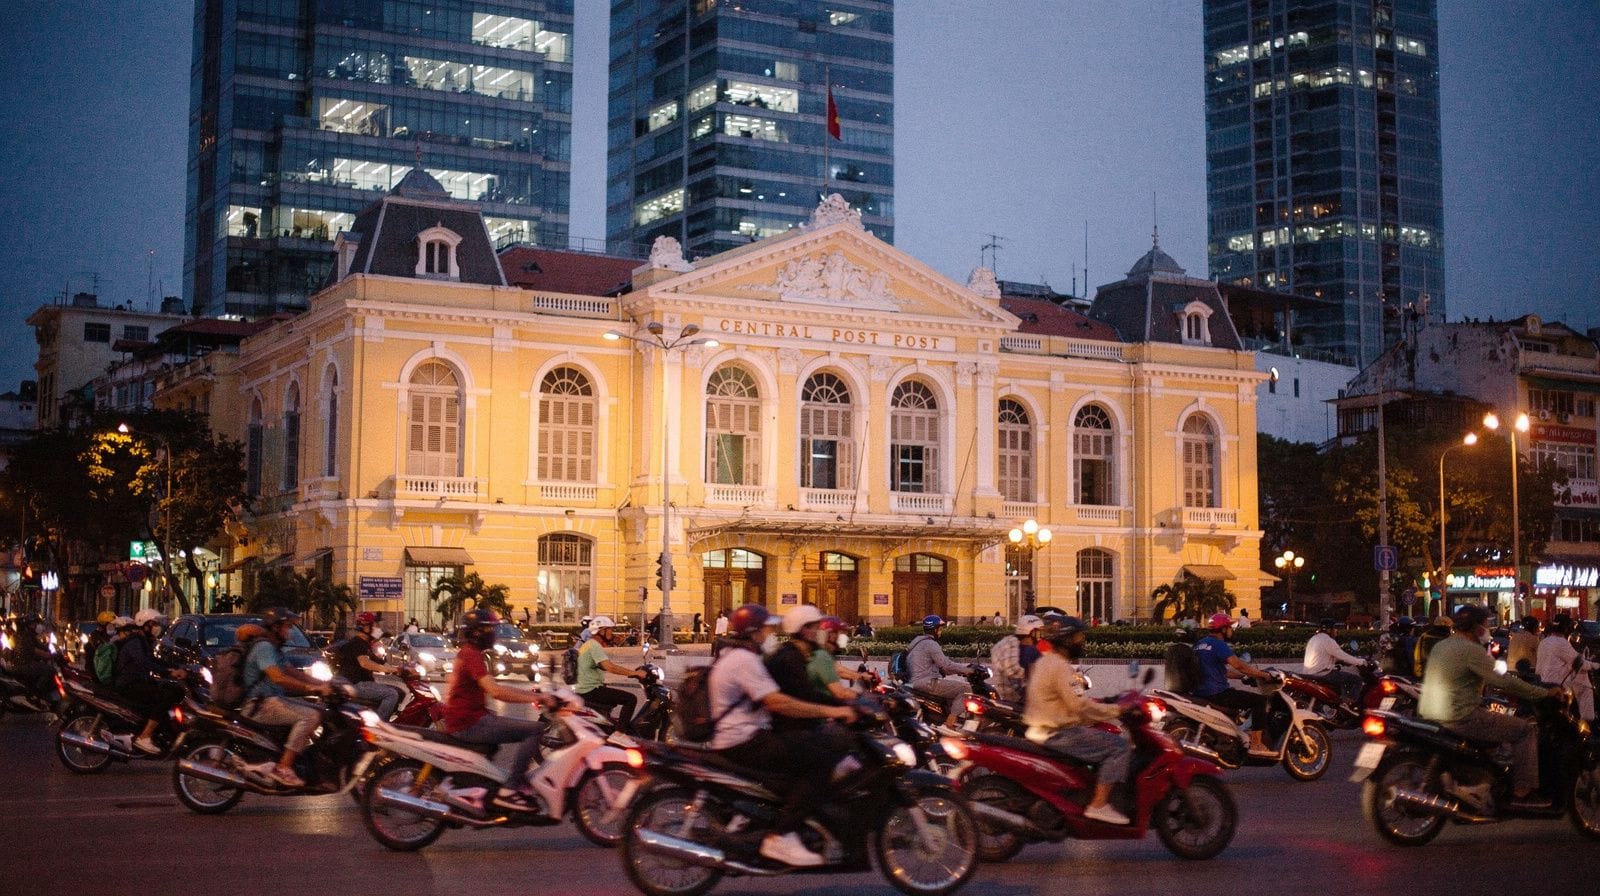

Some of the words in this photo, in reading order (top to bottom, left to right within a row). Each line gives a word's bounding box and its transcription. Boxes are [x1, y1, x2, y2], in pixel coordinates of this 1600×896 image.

[720, 319, 812, 339] CENTRAL
[832, 329, 879, 344] POST
[894, 335, 940, 349] POST
